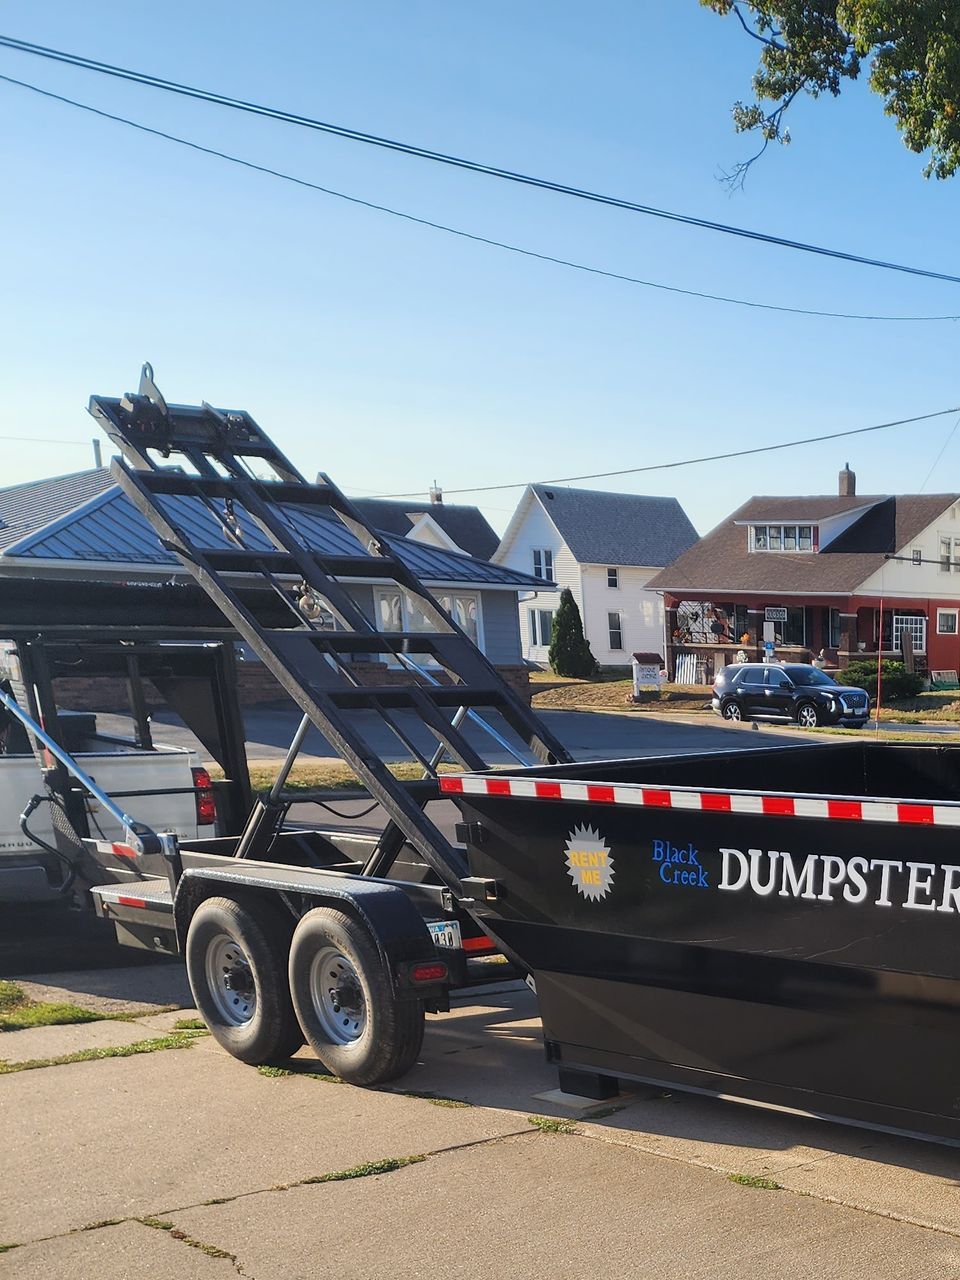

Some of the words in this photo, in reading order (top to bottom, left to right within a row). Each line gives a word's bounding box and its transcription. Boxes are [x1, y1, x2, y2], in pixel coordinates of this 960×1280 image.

[570, 850, 608, 867] RENT
[652, 839, 700, 866] Black
[580, 869, 602, 885] ME
[659, 862, 709, 888] Creek
